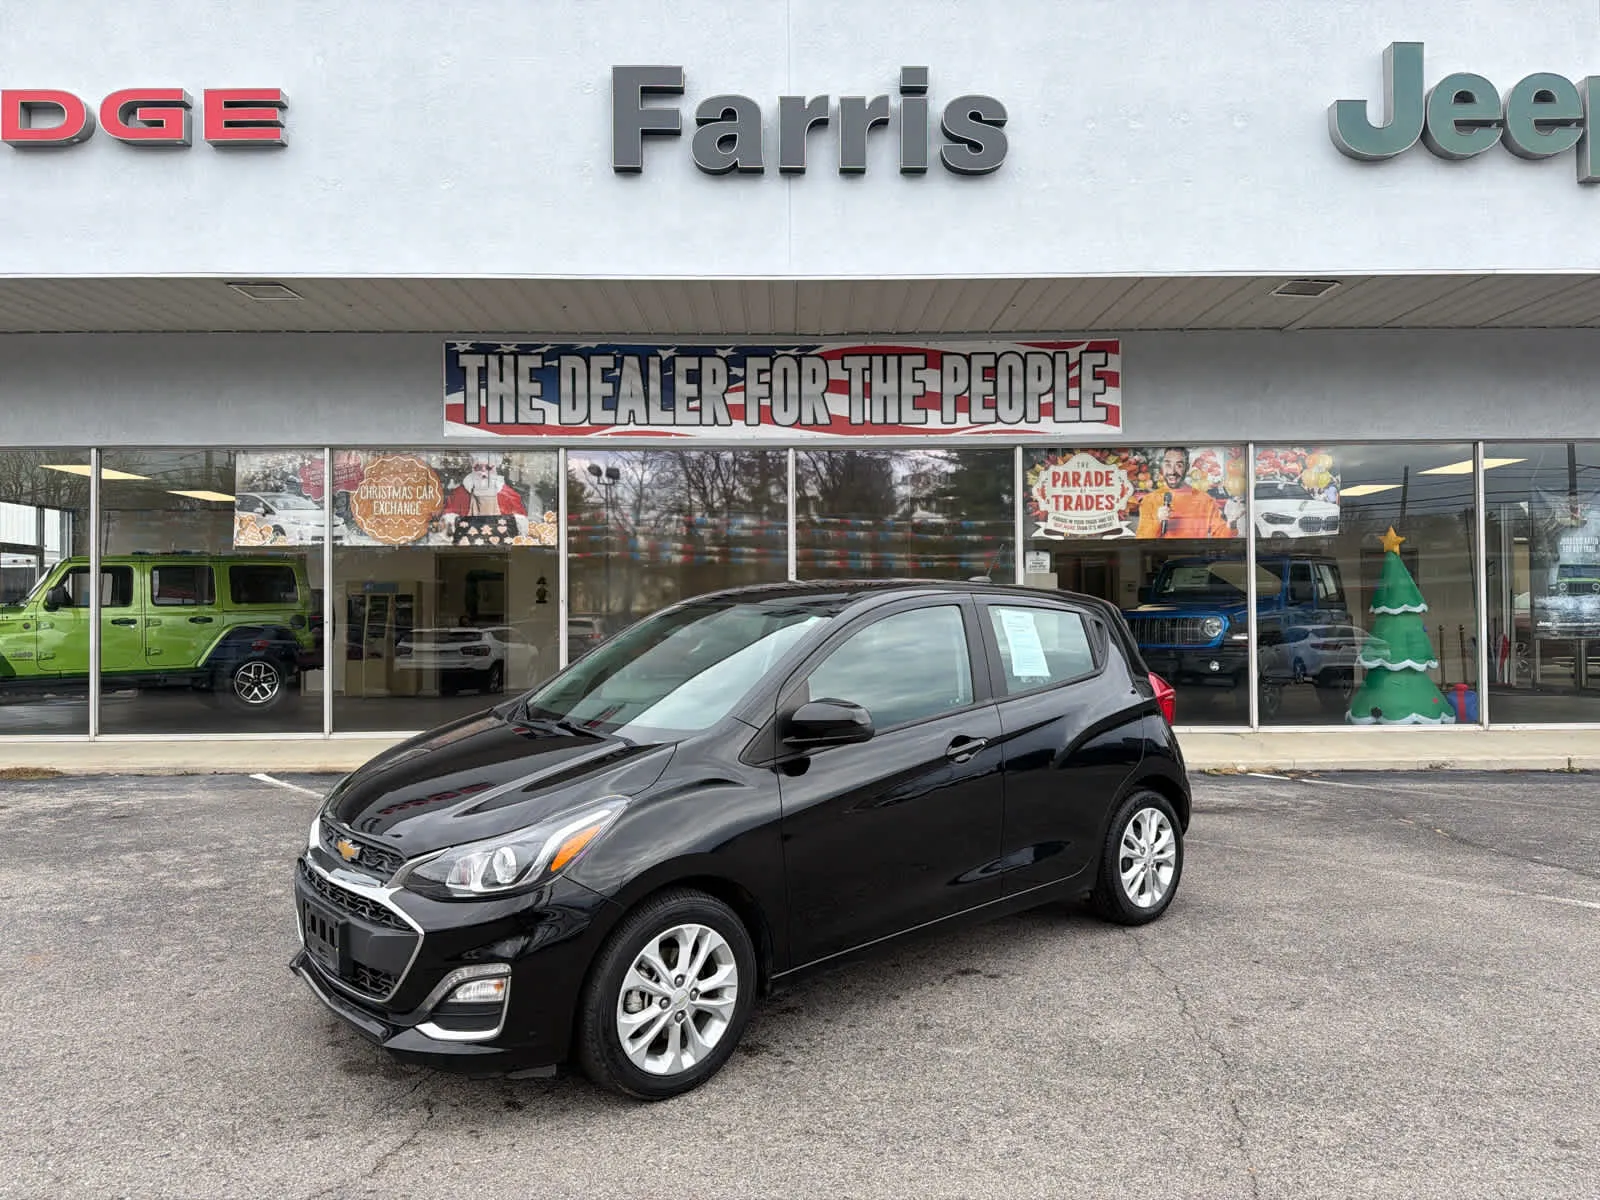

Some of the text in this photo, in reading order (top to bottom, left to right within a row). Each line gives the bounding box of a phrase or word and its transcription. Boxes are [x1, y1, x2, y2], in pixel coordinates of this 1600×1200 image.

[611, 65, 1008, 175] Farris
[1328, 42, 1600, 184] Jee
[458, 351, 1108, 426] THE DEALER FOR THE PEOPLE
[1052, 471, 1114, 488] PARADE
[360, 485, 435, 499] CHRISTMAS CAR
[374, 501, 421, 515] EXCHANGE
[1051, 495, 1115, 511] TRADES
